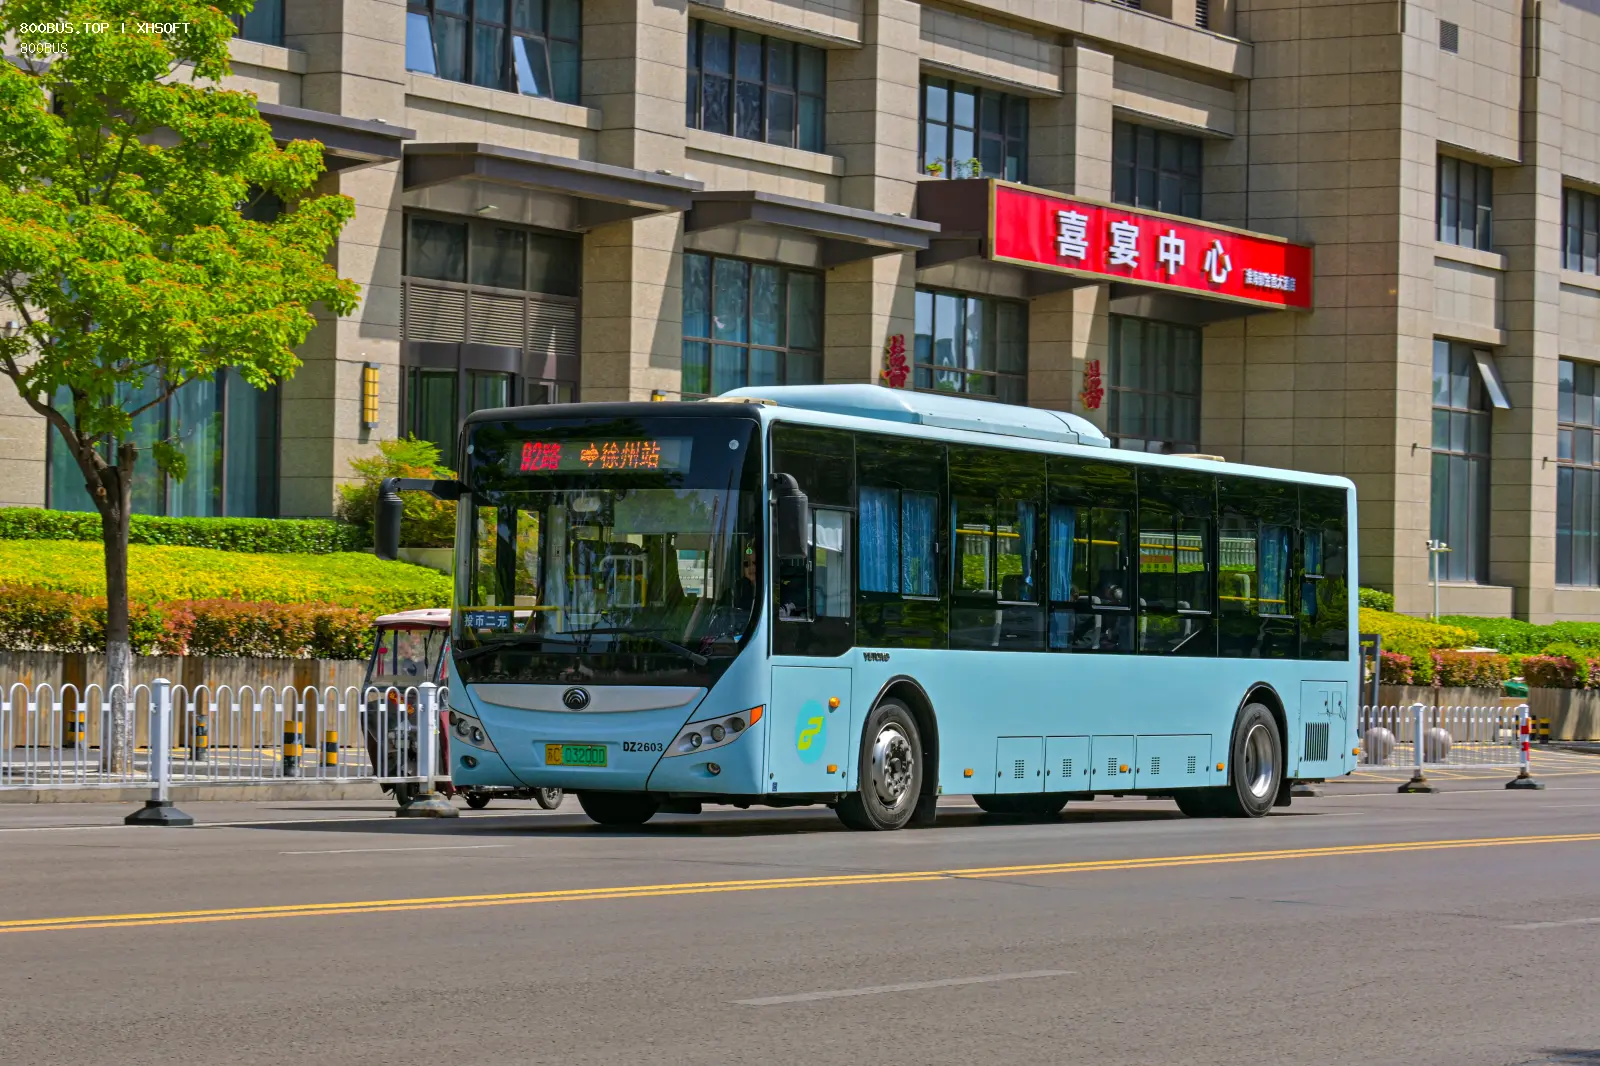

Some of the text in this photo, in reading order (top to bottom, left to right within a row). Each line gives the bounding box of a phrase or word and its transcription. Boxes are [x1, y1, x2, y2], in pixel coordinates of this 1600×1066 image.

[1056, 210, 1232, 283] 喜宴中心
[600, 441, 660, 468] 徐州站
[464, 614, 507, 626] 投币二元
[623, 741, 663, 752] DZ2603
